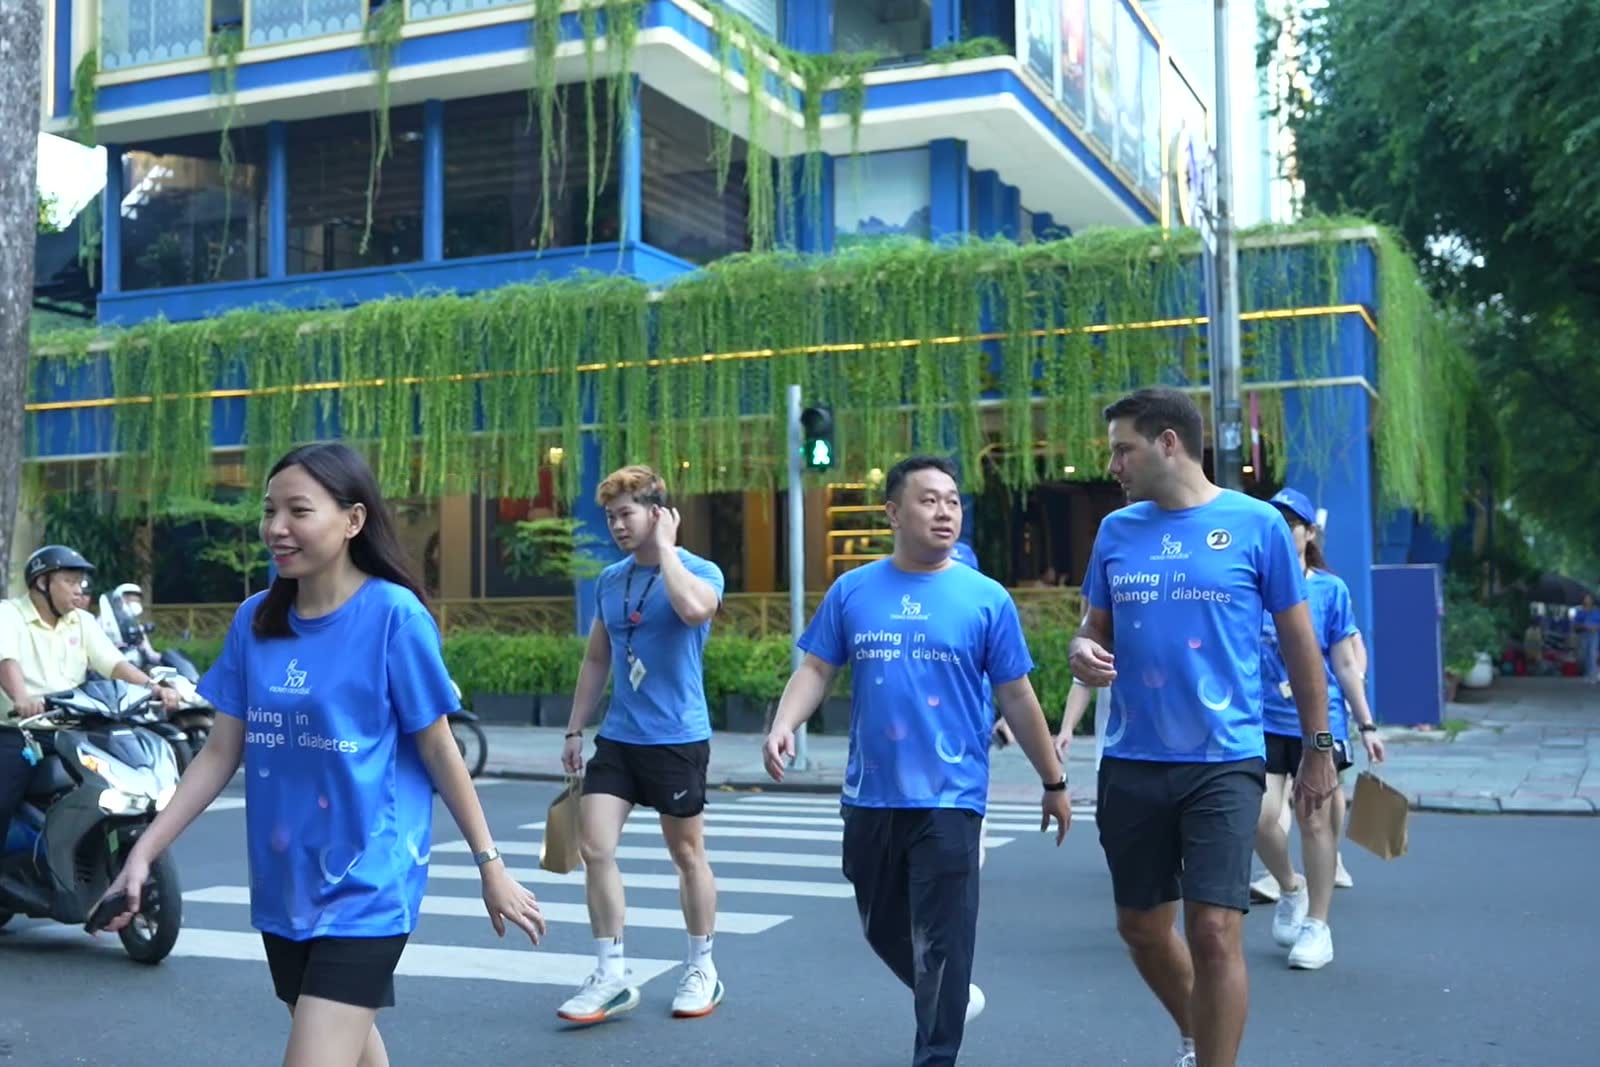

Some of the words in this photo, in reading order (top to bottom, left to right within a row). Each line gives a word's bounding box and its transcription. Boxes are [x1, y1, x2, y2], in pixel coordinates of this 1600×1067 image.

[1112, 571, 1160, 587] Driving
[1173, 570, 1186, 583] in
[1113, 589, 1159, 604] change
[1171, 586, 1231, 604] diabetes
[854, 629, 902, 645] Driving
[913, 631, 926, 643] in
[856, 647, 901, 662] change
[295, 711, 309, 725] in
[245, 732, 285, 748] ange
[298, 732, 359, 753] diabetes
